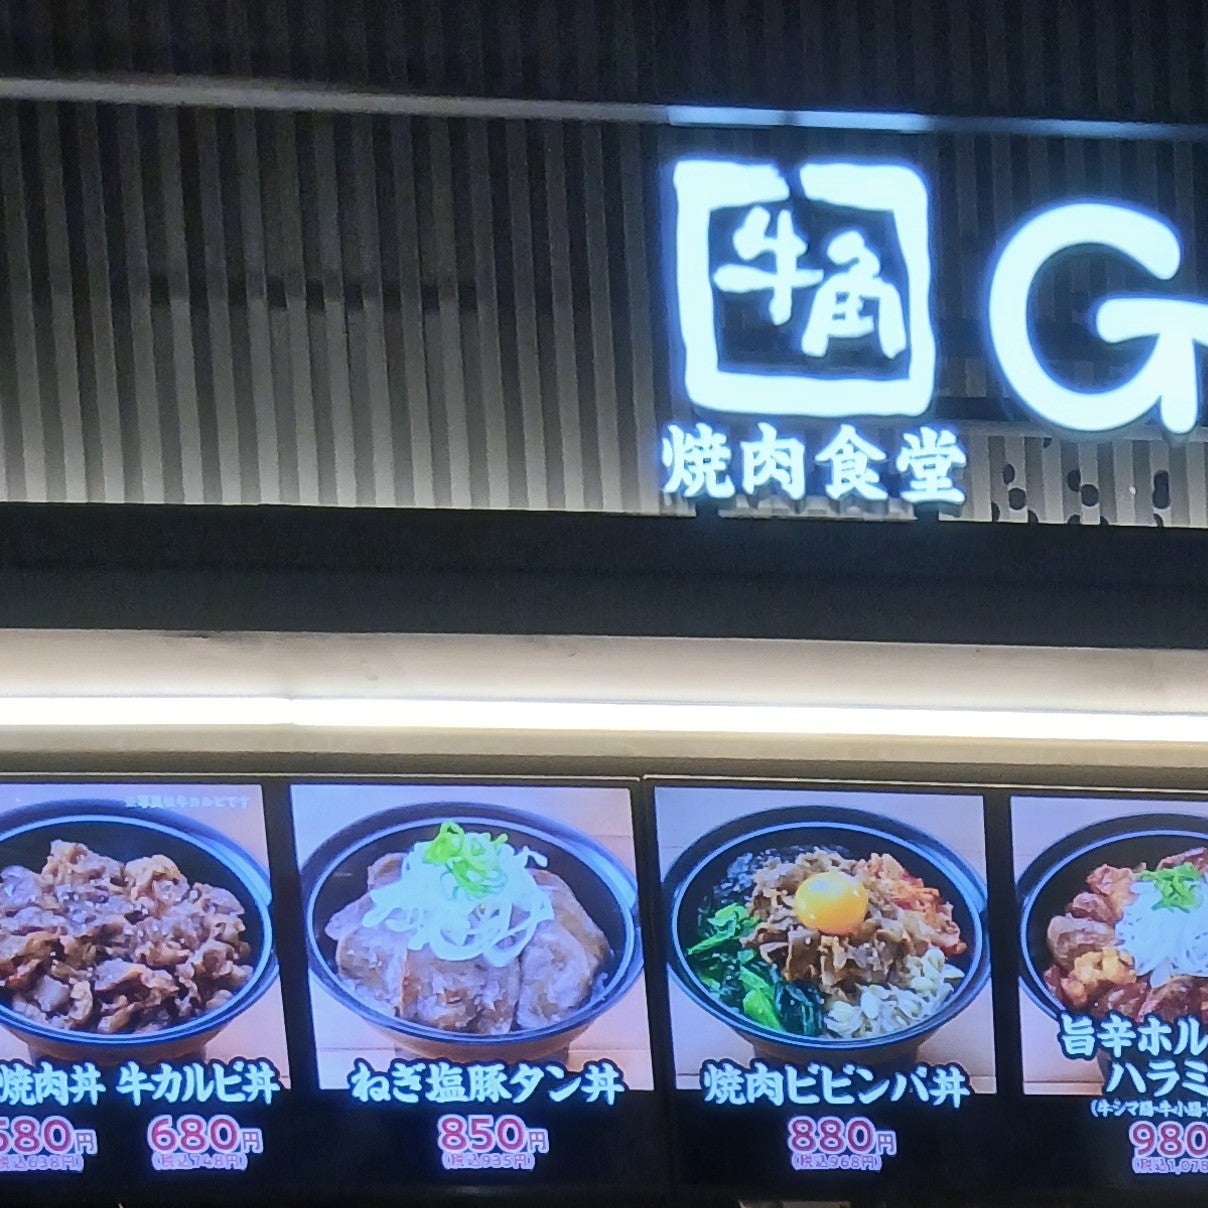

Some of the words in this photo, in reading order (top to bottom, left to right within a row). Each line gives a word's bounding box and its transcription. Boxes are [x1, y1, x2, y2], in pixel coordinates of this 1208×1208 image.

[714, 206, 908, 358] 牛角
[661, 423, 968, 505] 焼肉食堂
[115, 1061, 281, 1106] 牛カルビ丼
[349, 1061, 625, 1106] ねぎ塩豚タン丼
[702, 1063, 971, 1107] 焼肉ビビンバ丼
[150, 1117, 262, 1153] 680円
[439, 1116, 548, 1153] 850円
[789, 1118, 896, 1155] 880円
